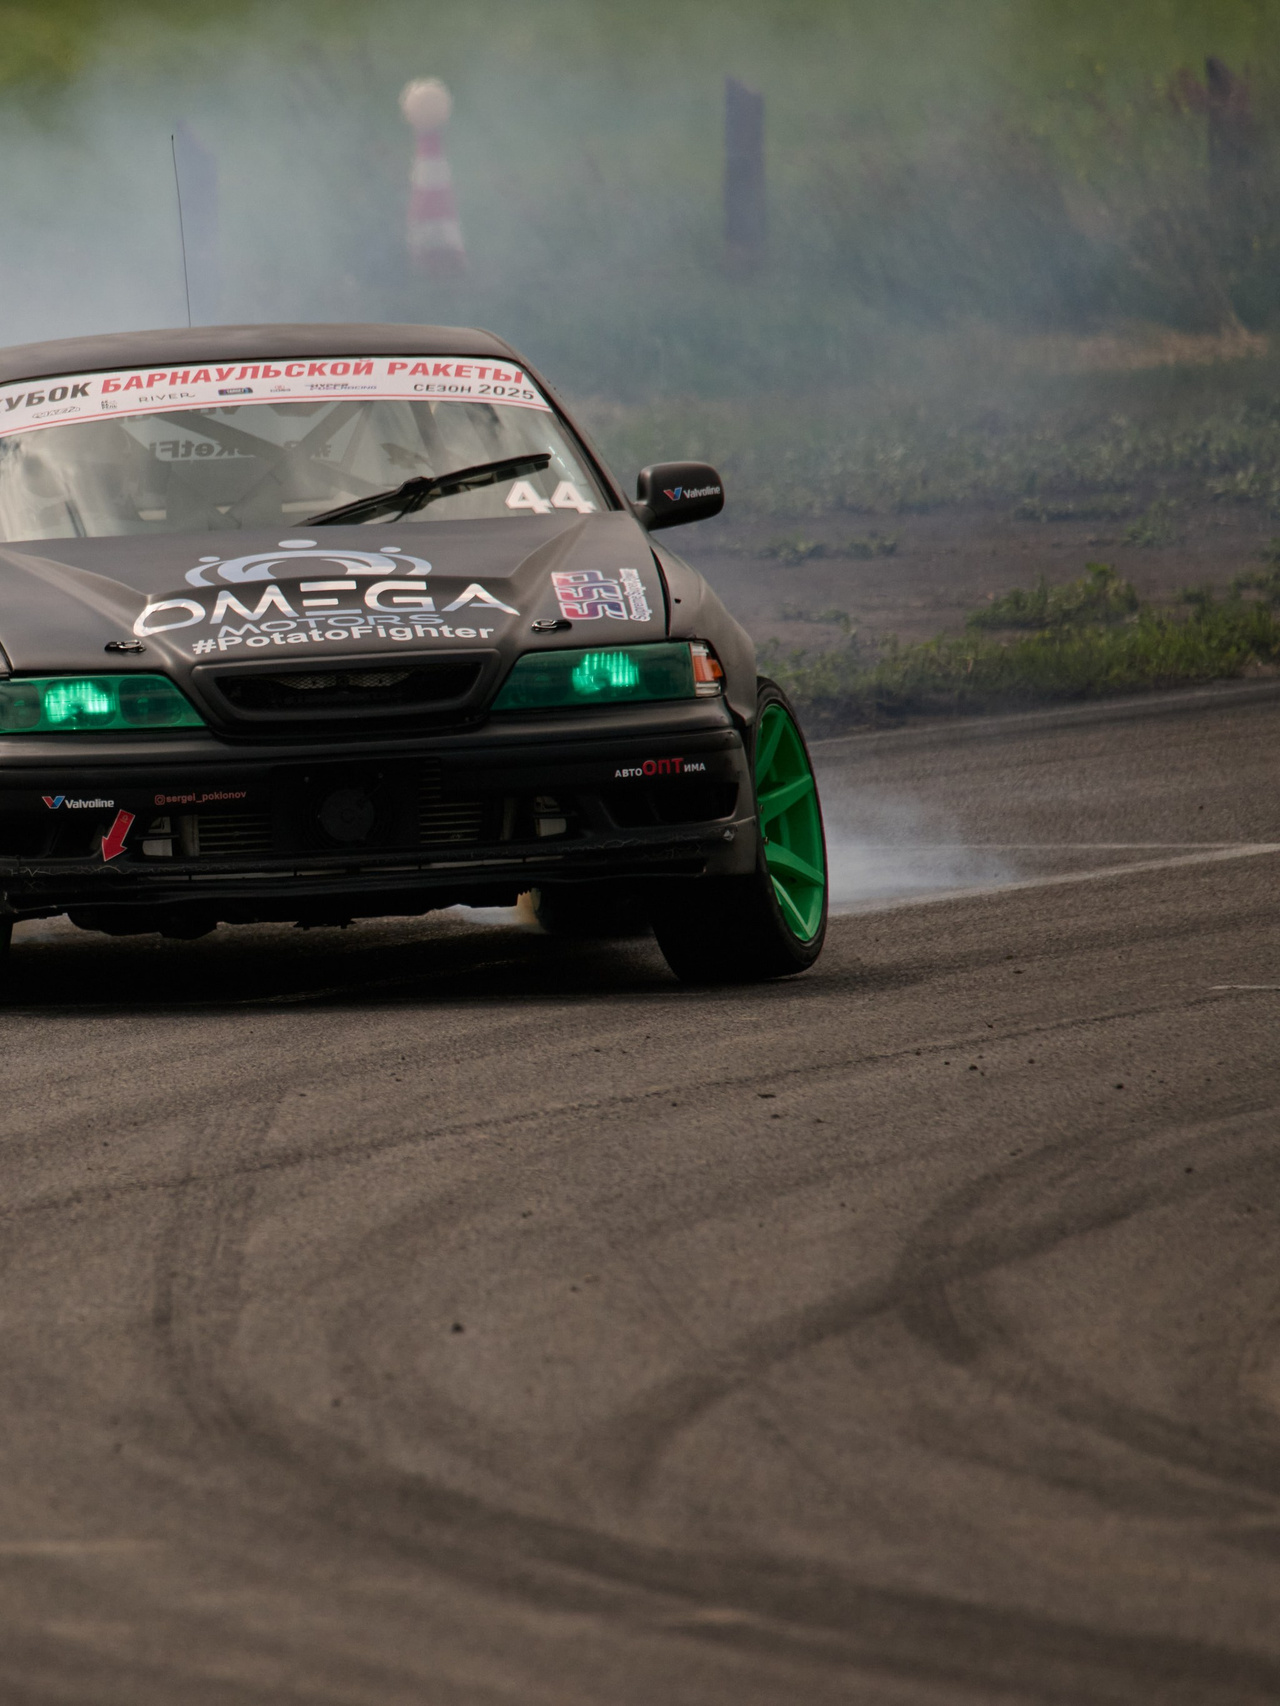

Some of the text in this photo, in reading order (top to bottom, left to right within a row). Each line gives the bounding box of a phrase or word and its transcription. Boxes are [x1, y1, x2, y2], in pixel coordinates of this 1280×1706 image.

[101, 358, 375, 394] БАРНАУЛЬСКОЙ
[387, 361, 525, 384] РАКЕТЫ
[138, 391, 197, 404] RIVER
[413, 383, 535, 400] СЕЗОН 2025
[505, 481, 597, 514] 44
[683, 486, 721, 499] Valvoline
[133, 580, 521, 637] OMEGA
[218, 613, 445, 637] MOTORS
[192, 624, 494, 655] #PotatoFighter
[65, 798, 114, 809] Valvoline
